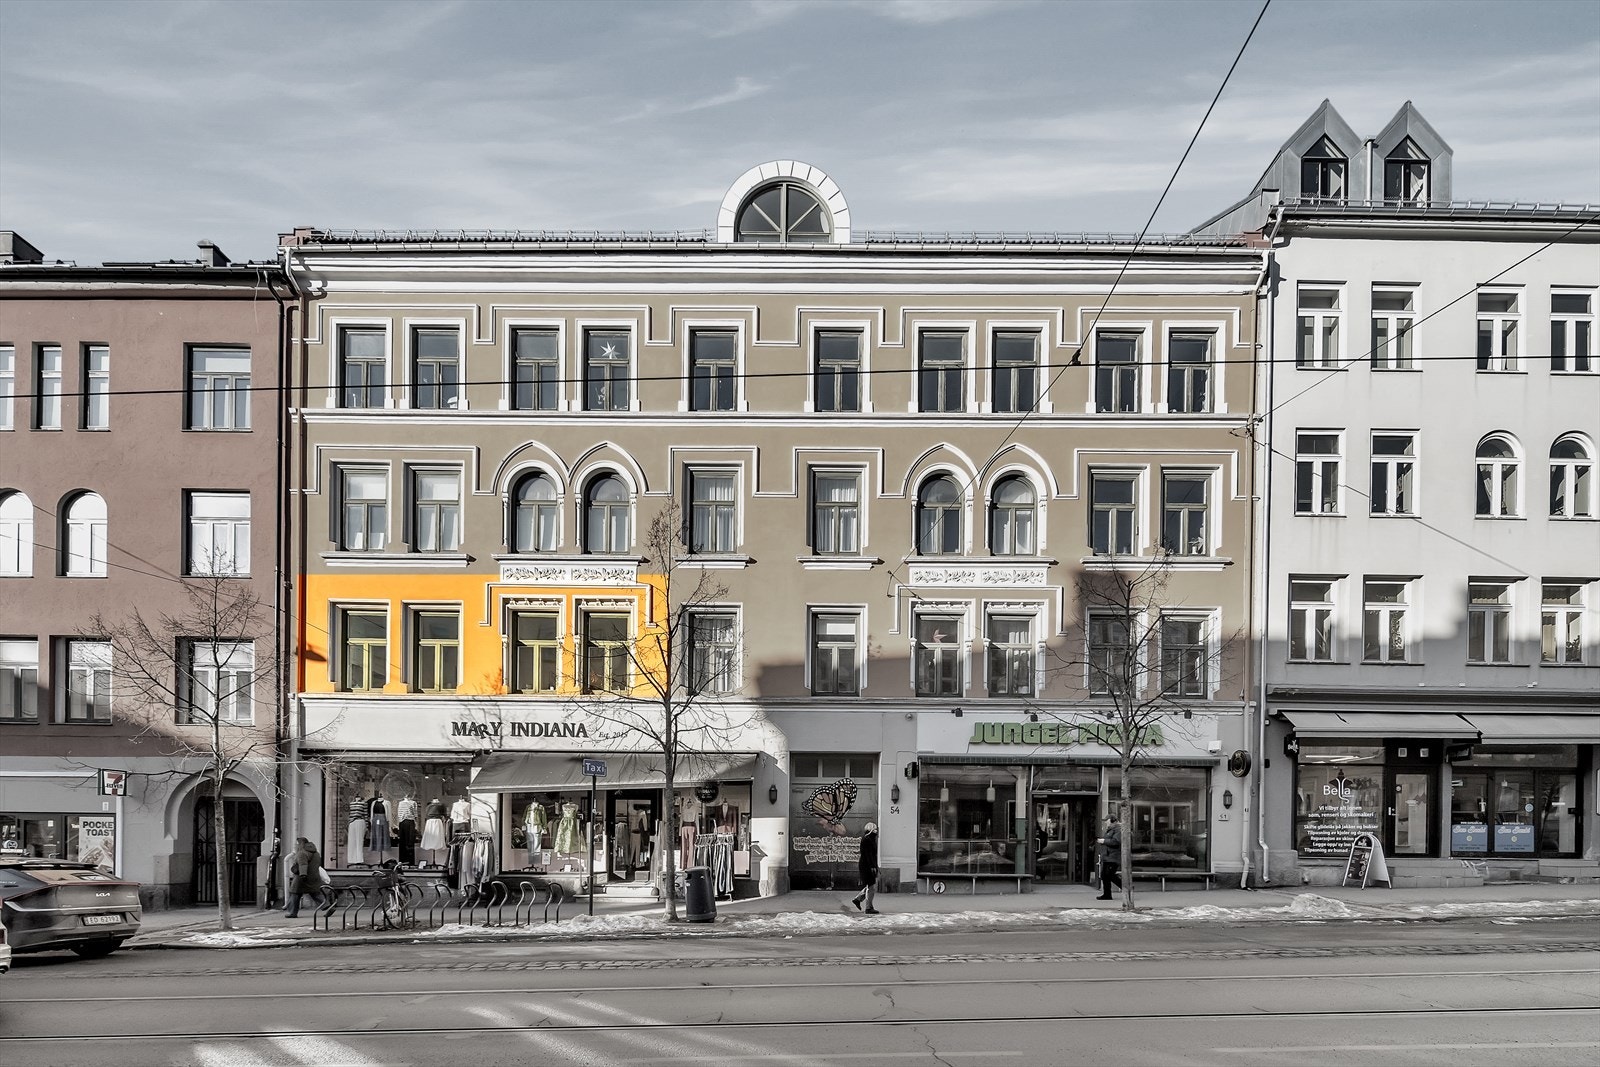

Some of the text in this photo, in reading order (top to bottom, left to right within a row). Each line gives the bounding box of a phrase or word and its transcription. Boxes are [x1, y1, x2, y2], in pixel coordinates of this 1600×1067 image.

[451, 721, 588, 740] MARY INDIANA
[969, 722, 1074, 744] JUNGEL
[585, 762, 604, 772] Taxi
[1323, 777, 1351, 804] Bella
[890, 806, 900, 815] 54
